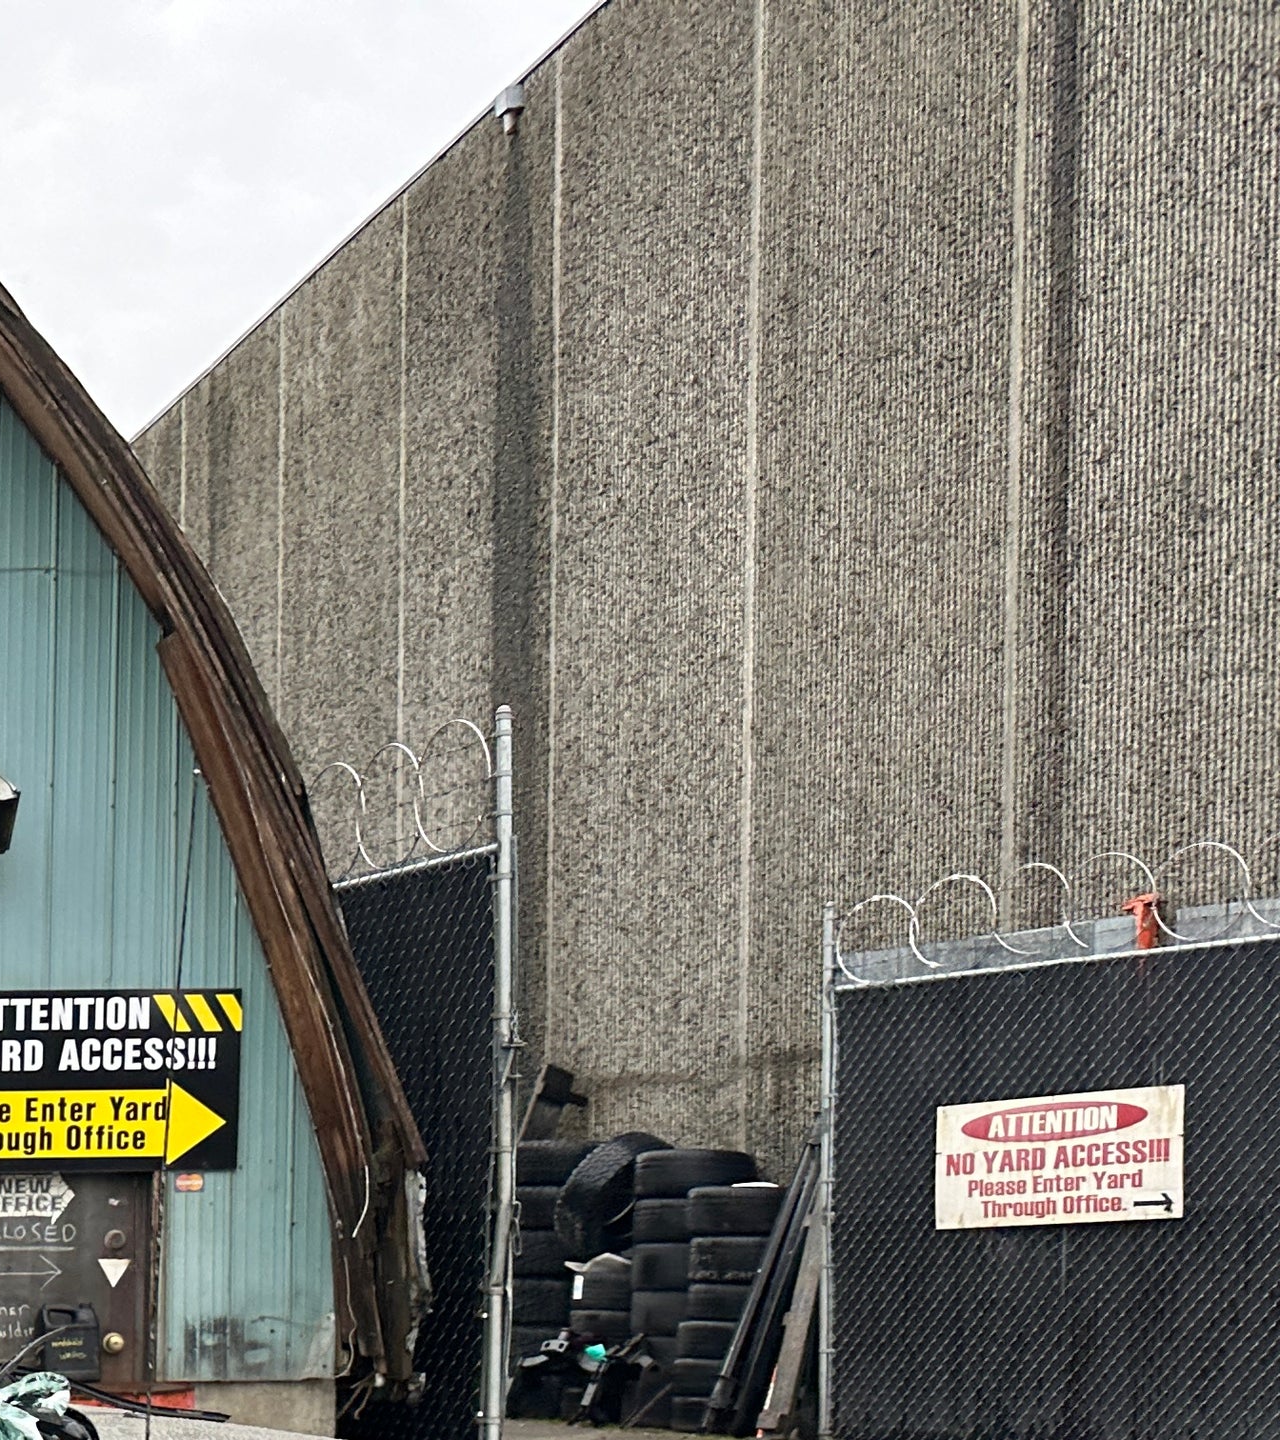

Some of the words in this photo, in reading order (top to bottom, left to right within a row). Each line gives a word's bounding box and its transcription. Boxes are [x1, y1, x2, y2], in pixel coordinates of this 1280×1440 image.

[58, 1037, 217, 1071] ACCESS!!!
[25, 1097, 97, 1122] Enter
[110, 1095, 167, 1121] Yard
[987, 1104, 1119, 1139] ATTENTION
[66, 1125, 146, 1151] Office
[946, 1152, 975, 1176] NO
[981, 1148, 1046, 1174] YARD
[1053, 1137, 1171, 1169] ACCESS!!!
[967, 1178, 1027, 1198] Please
[1032, 1174, 1087, 1194] Enter
[1092, 1169, 1144, 1189] Yard
[981, 1199, 1057, 1219] Through
[1063, 1194, 1128, 1215] Office.
